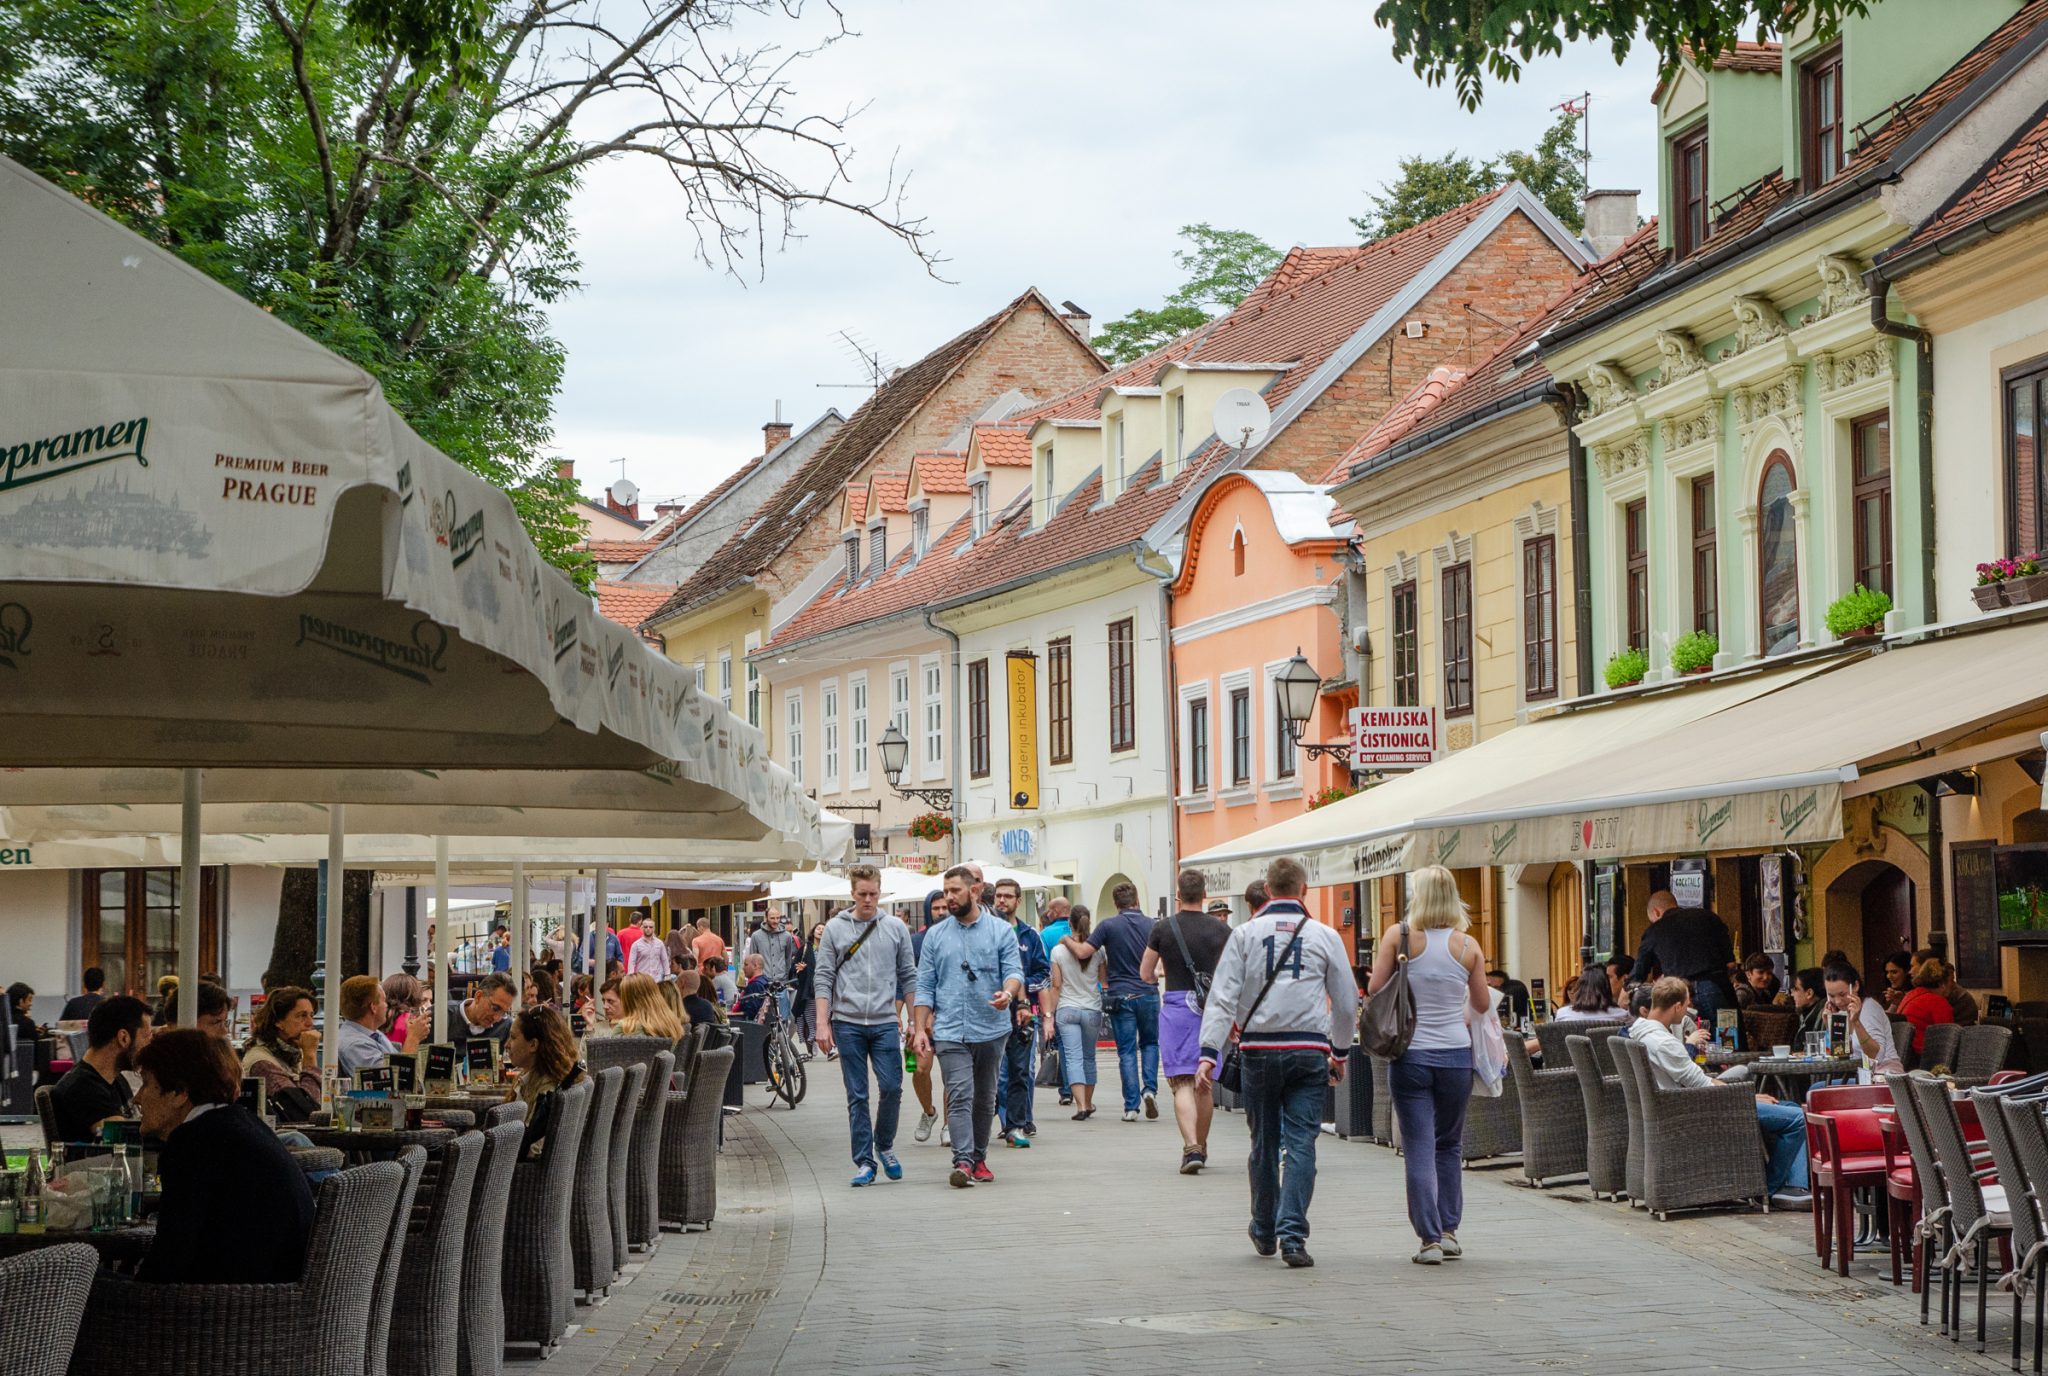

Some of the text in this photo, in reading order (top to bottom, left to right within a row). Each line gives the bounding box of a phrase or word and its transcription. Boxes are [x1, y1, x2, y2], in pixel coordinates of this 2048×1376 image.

[215, 453, 329, 477] PREMIUM BEER
[222, 477, 317, 506] PRAGUE
[1016, 668, 1032, 783] galerija inkubator
[1361, 711, 1429, 727] KEMIJSKA
[1360, 729, 1430, 748] ČISTIONICA
[1362, 753, 1429, 762] DRY CLEANING SERVICE
[1002, 828, 1030, 855] MIXER
[1262, 934, 1305, 981] 14
